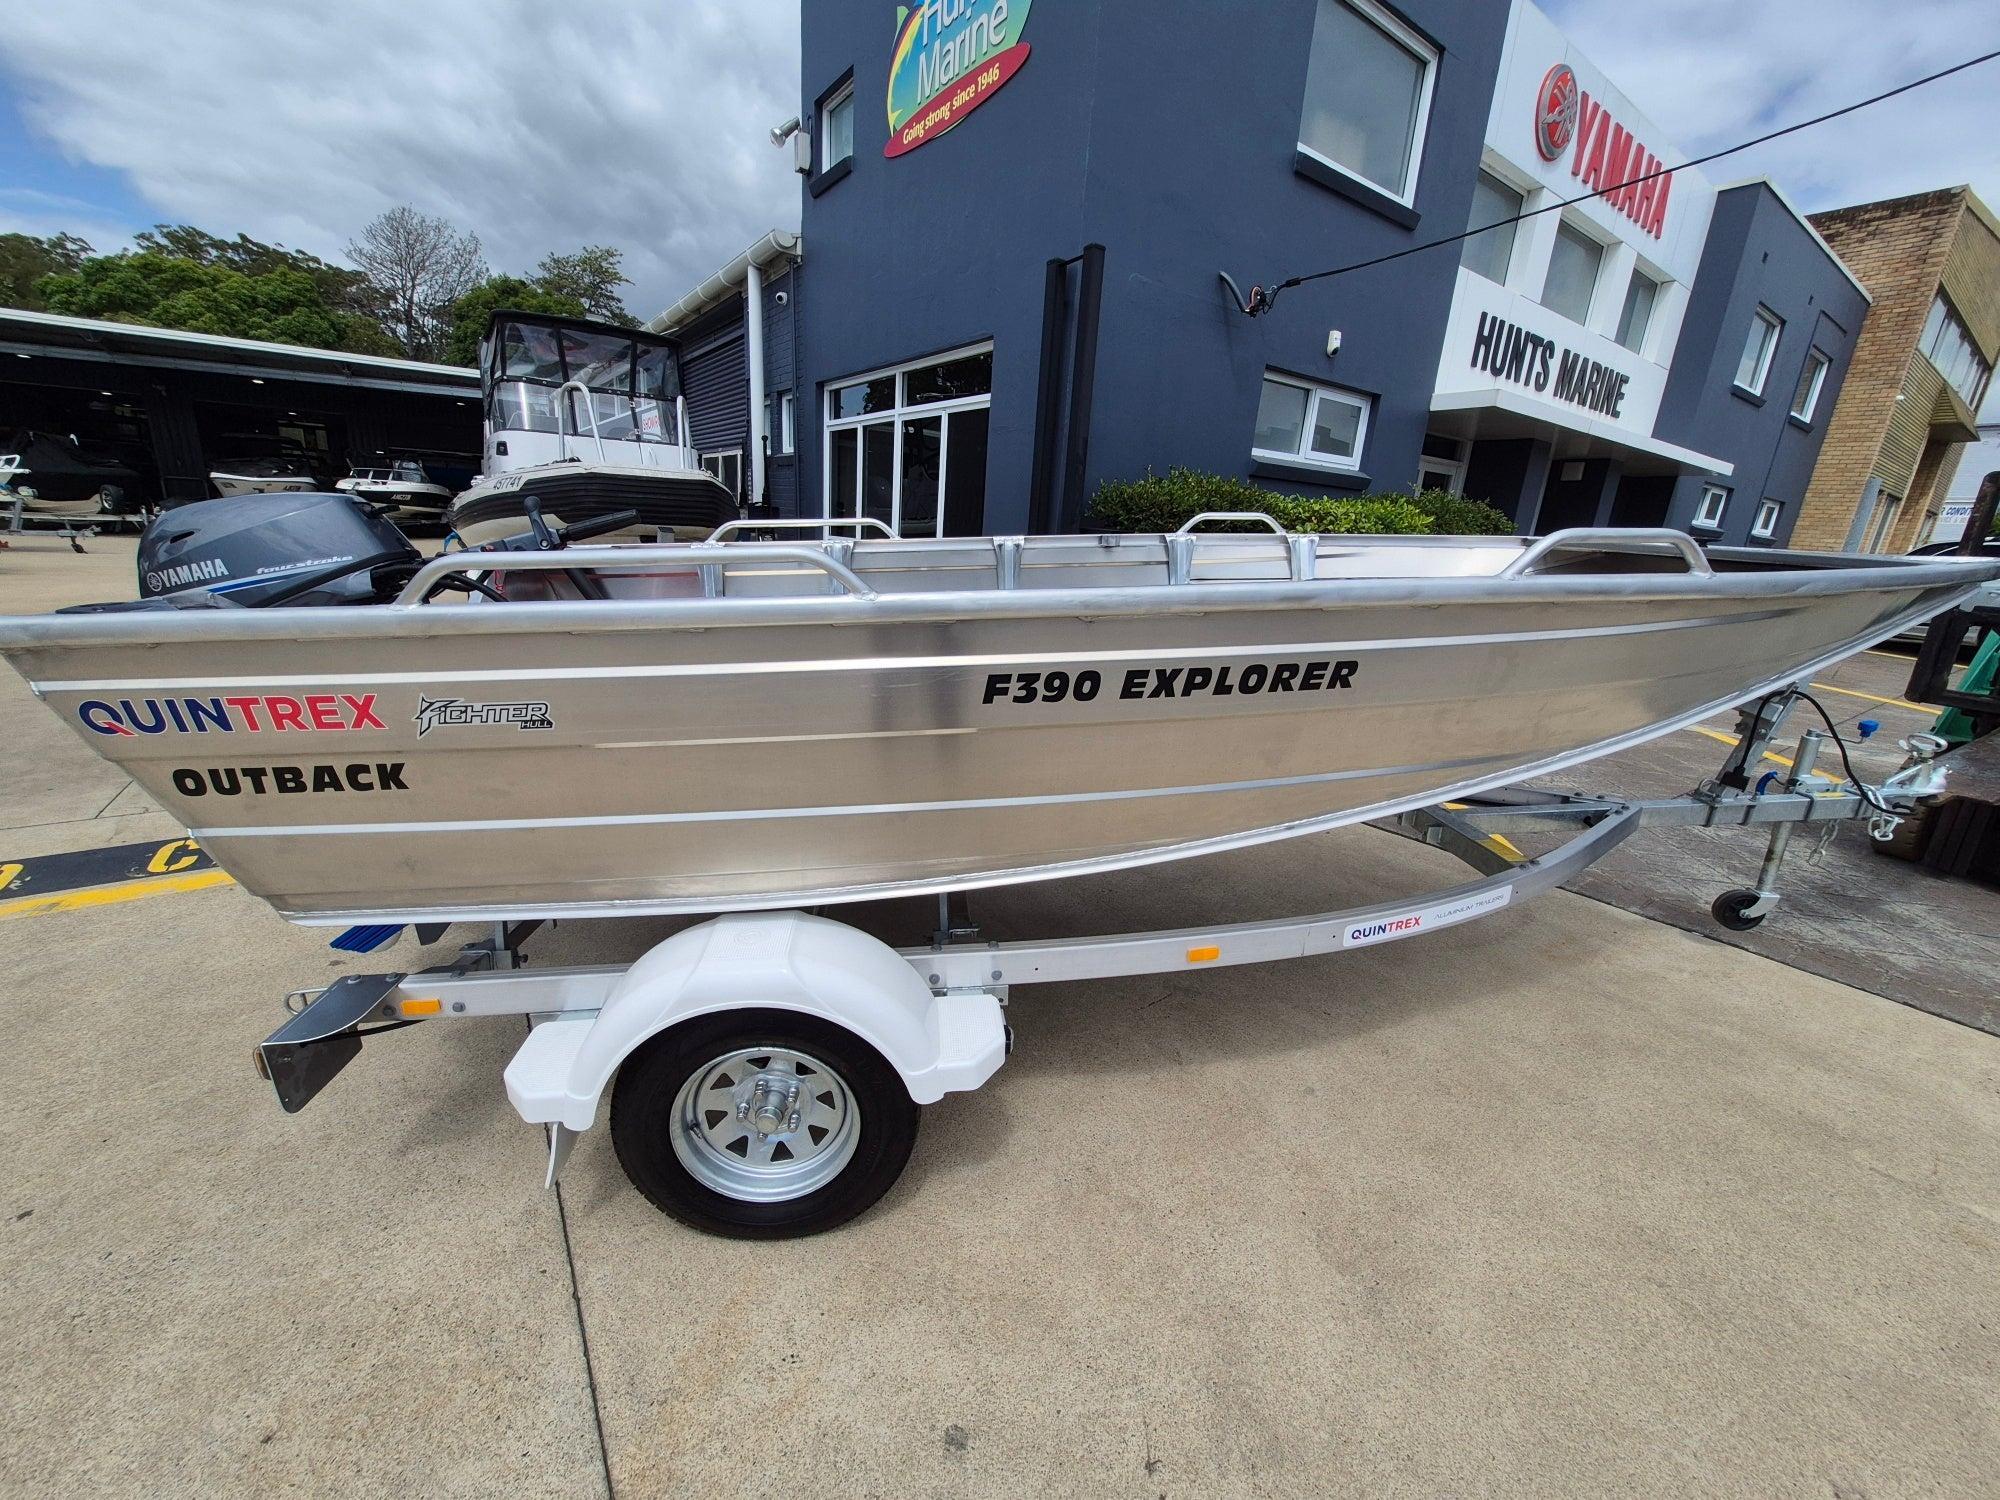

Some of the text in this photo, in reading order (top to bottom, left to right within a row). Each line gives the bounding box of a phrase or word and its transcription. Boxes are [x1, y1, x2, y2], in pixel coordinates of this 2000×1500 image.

[917, 0, 1008, 104] Marine
[903, 62, 1000, 145] Going strong since 1946
[1571, 90, 1673, 240] YAMAHA
[1471, 311, 1631, 419] HUNTS MARINE
[159, 558, 230, 588] YAMAHA
[982, 659, 1359, 705] F390 EXPLORER
[78, 693, 389, 738] QUINTREX
[520, 720, 552, 730] HULL
[172, 762, 410, 797] OUTBACK
[1351, 915, 1423, 940] QUINTREX
